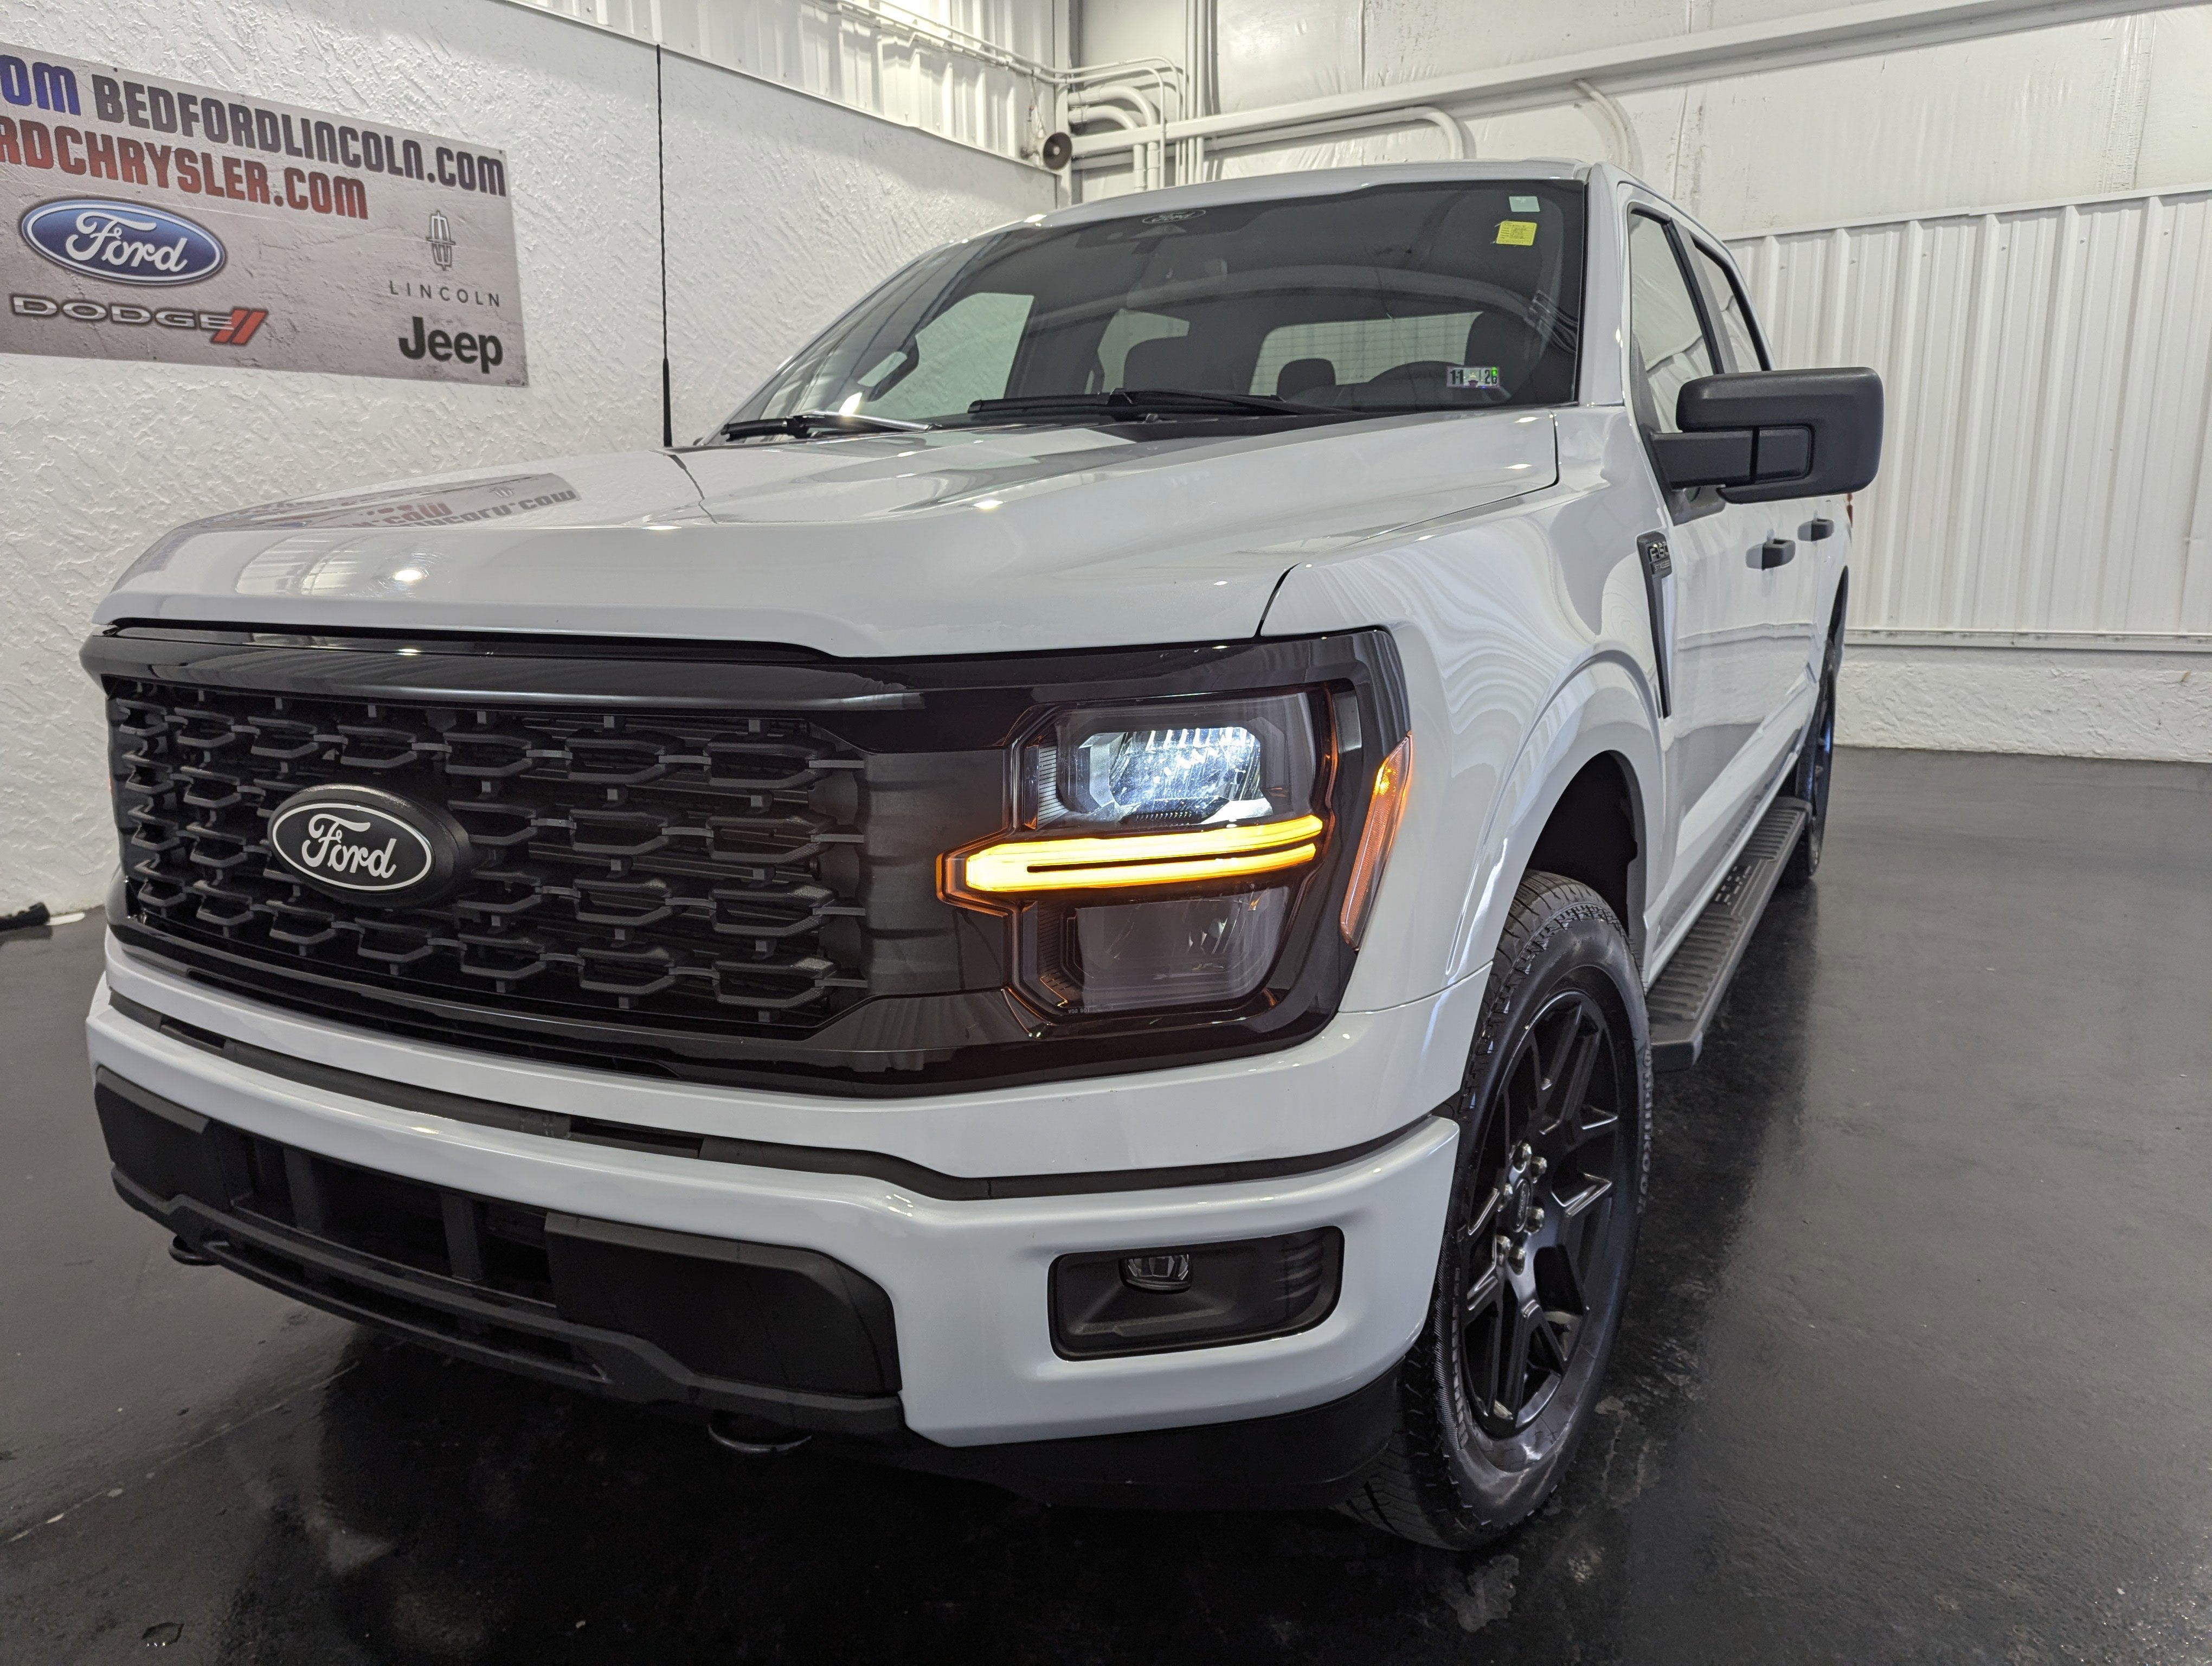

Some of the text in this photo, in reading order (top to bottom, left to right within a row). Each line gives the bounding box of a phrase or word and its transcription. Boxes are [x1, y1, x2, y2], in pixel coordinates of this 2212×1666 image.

[92, 74, 506, 197] BEDFORDLINCOLN.COM
[66, 211, 188, 272] Ford
[12, 295, 235, 331] DODGE
[389, 280, 500, 307] LINCOLN
[398, 316, 504, 375] Jeep
[301, 813, 397, 879] Ford
